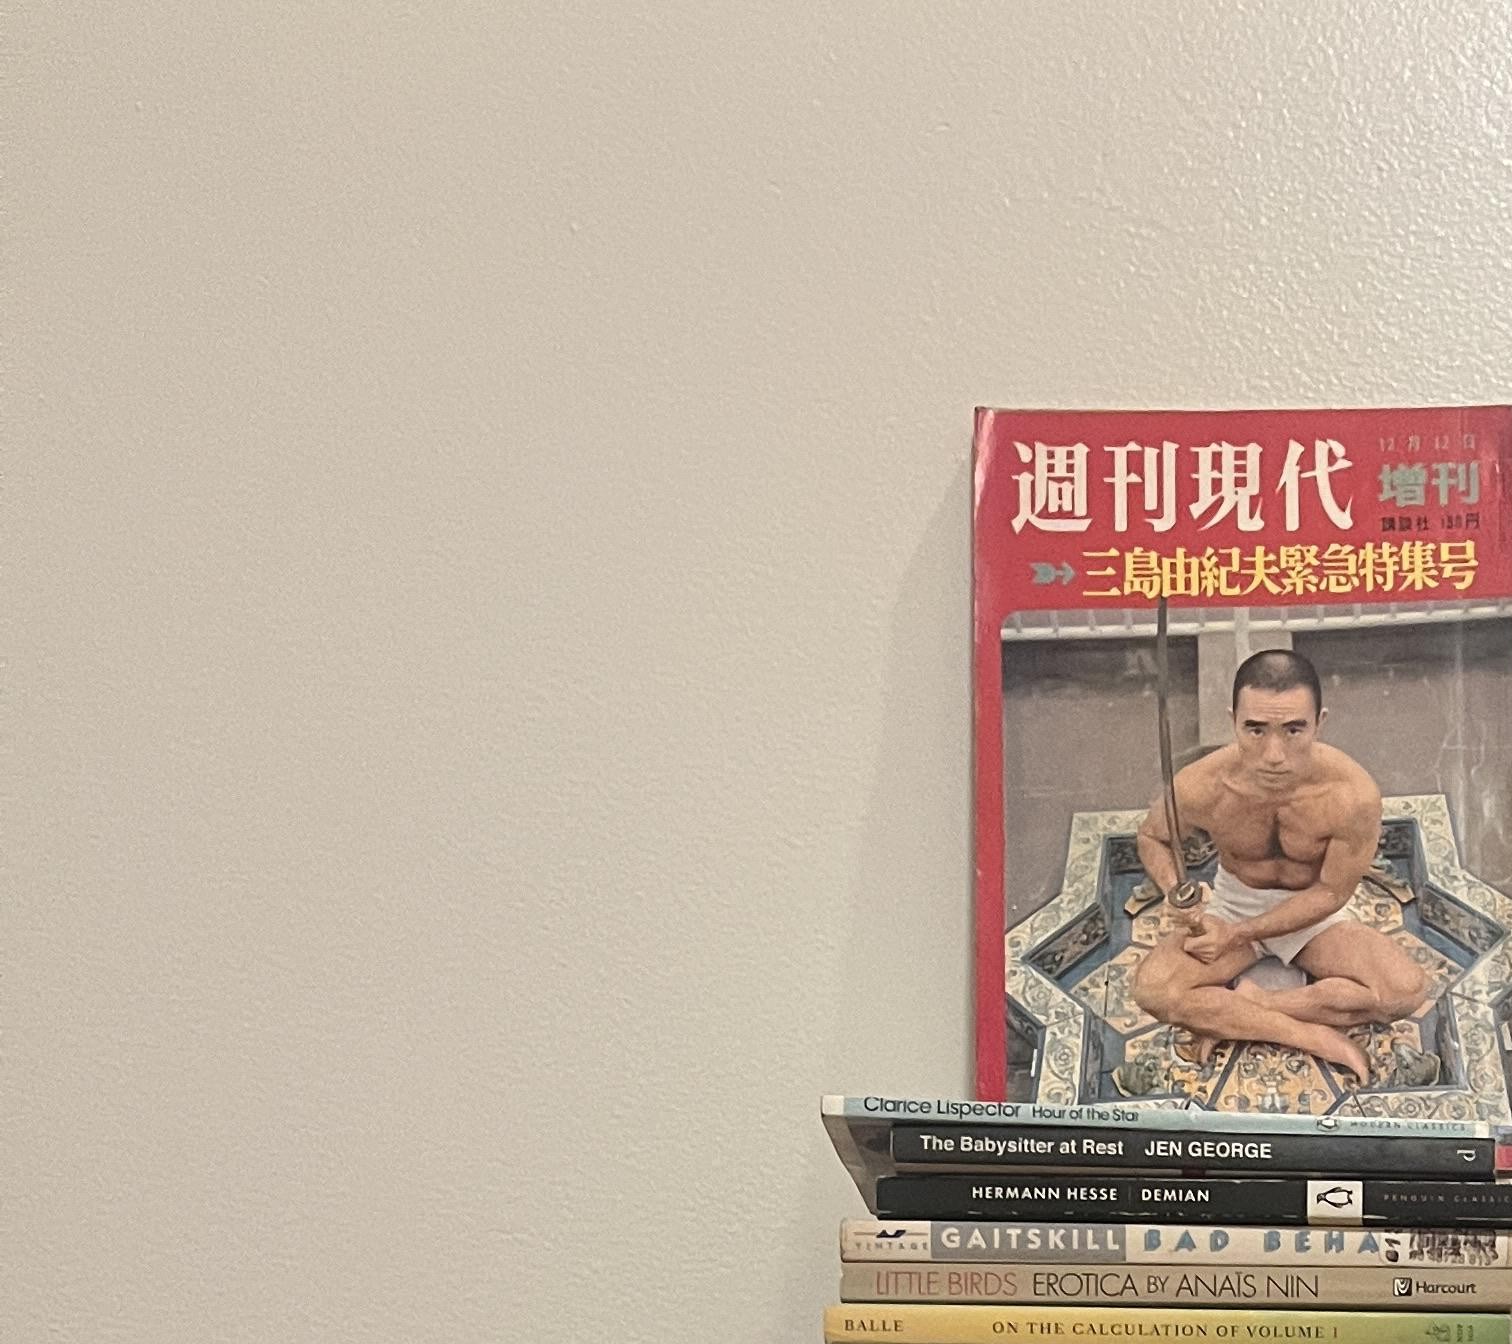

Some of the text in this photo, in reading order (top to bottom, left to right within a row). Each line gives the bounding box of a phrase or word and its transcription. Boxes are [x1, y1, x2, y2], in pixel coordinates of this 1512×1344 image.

[1011, 439, 1354, 534] 週刊現代
[1082, 540, 1478, 598] 三島由紀夫緊急特集号
[921, 1136, 1272, 1160] The Babysitter at Rest JEN GEORGE
[972, 1186, 1210, 1203] HERMANN HESSE DEMIAN
[940, 1226, 1121, 1252] GAITSKILL
[1032, 1270, 1319, 1298] EROTICA BY ANAÏS NIN
[1415, 1280, 1477, 1296] Harcourt
